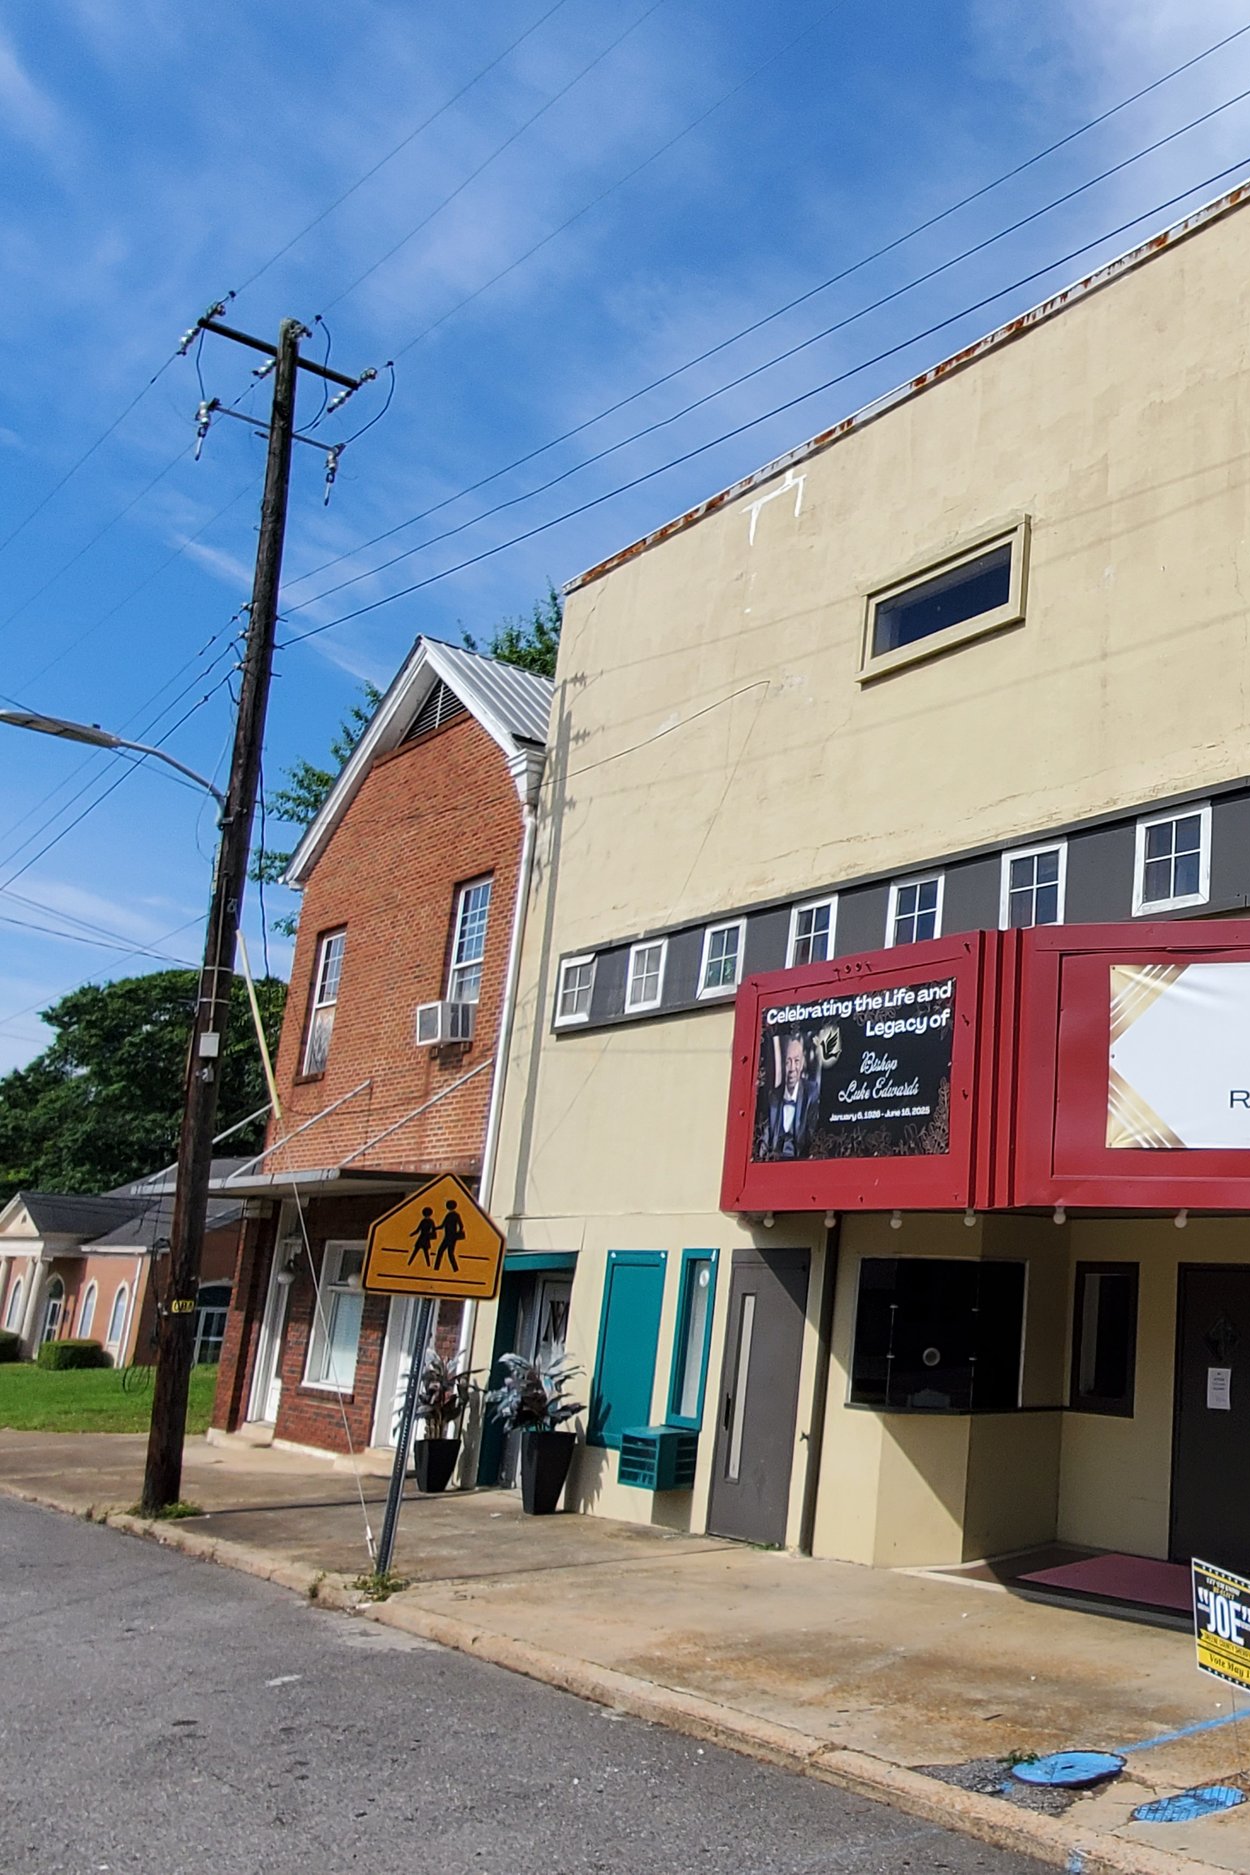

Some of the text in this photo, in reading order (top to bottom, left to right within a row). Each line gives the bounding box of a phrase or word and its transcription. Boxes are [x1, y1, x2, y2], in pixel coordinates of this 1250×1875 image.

[767, 980, 952, 1025] Celebrating the Life and
[865, 1009, 951, 1039] Legacy of
[860, 1051, 897, 1078] Bishop
[838, 1077, 920, 1103] Luke Edwards
[829, 1112, 857, 1122] January
[885, 1105, 900, 1117] June
[1209, 1653, 1227, 1668] Vote
[1226, 1660, 1245, 1679] May
